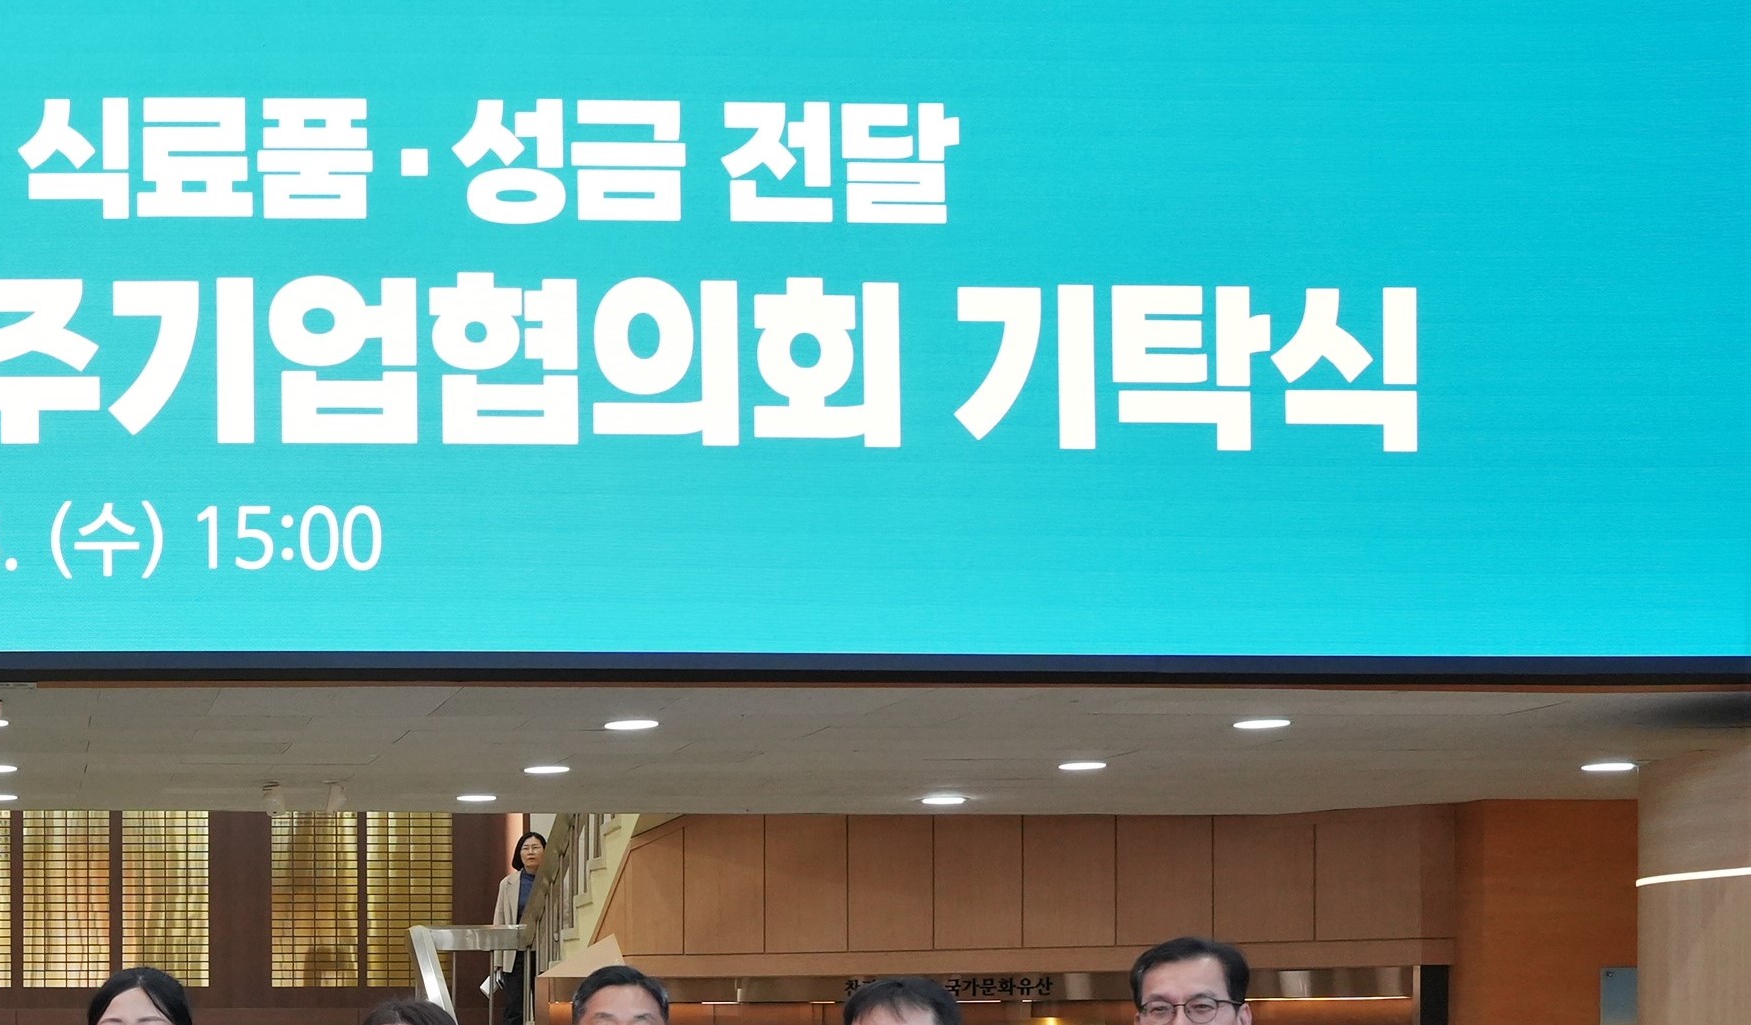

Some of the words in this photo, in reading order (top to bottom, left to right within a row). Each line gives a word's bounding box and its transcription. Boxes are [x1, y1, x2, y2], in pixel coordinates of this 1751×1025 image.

[720, 101, 960, 225] 전달
[953, 284, 1418, 453] 기탁식
[50, 500, 164, 580] (수)
[196, 504, 383, 572] 15:00
[944, 976, 1053, 997] 국가문화유산
